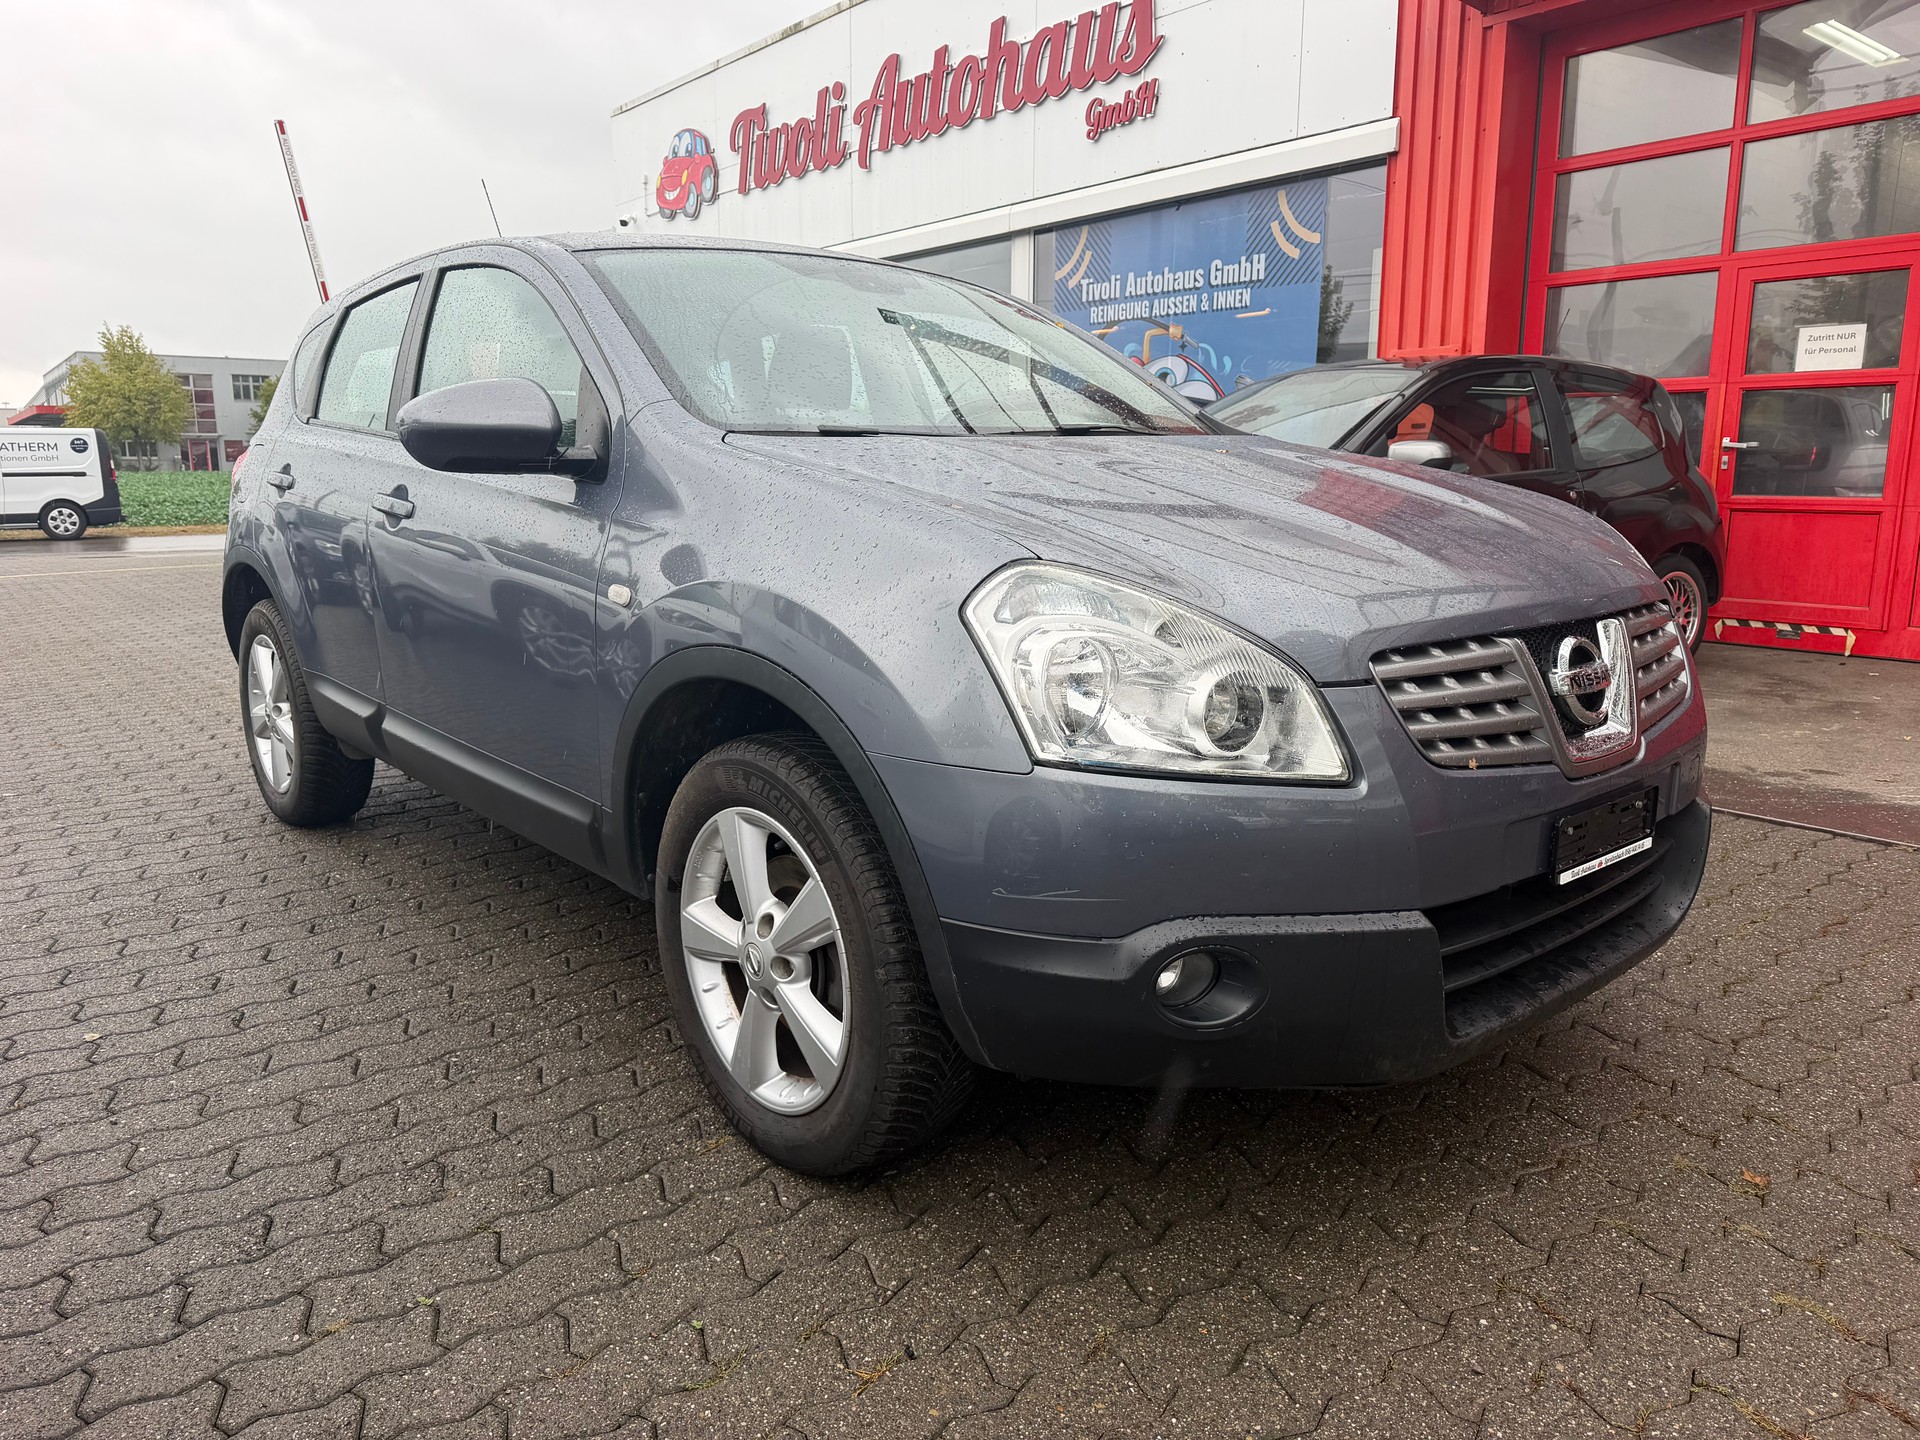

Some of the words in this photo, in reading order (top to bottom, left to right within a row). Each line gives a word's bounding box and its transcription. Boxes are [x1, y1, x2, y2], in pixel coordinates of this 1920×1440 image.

[729, 81, 848, 195] Tivoli
[854, 0, 1165, 171] Autohaus
[1085, 78, 1160, 142] GmbH
[282, 138, 292, 158] AUTO
[287, 157, 299, 178] TIVOLI
[304, 224, 314, 242] AUTO
[310, 242, 320, 263] TIVOLI
[1081, 274, 1121, 302] Tivoli
[1125, 268, 1204, 298] Autohaus
[1210, 253, 1266, 286] GmbH
[1090, 299, 1150, 324] REINIGUNG
[1152, 293, 1198, 317] AUSSEN
[1201, 293, 1209, 311] &
[1212, 288, 1251, 310] INNEN
[1804, 347, 1817, 355] für
[1818, 345, 1857, 354] Personal
[1807, 333, 1835, 342] Zutritt
[1836, 332, 1857, 340] NUR
[747, 776, 828, 862] MICHELIN
